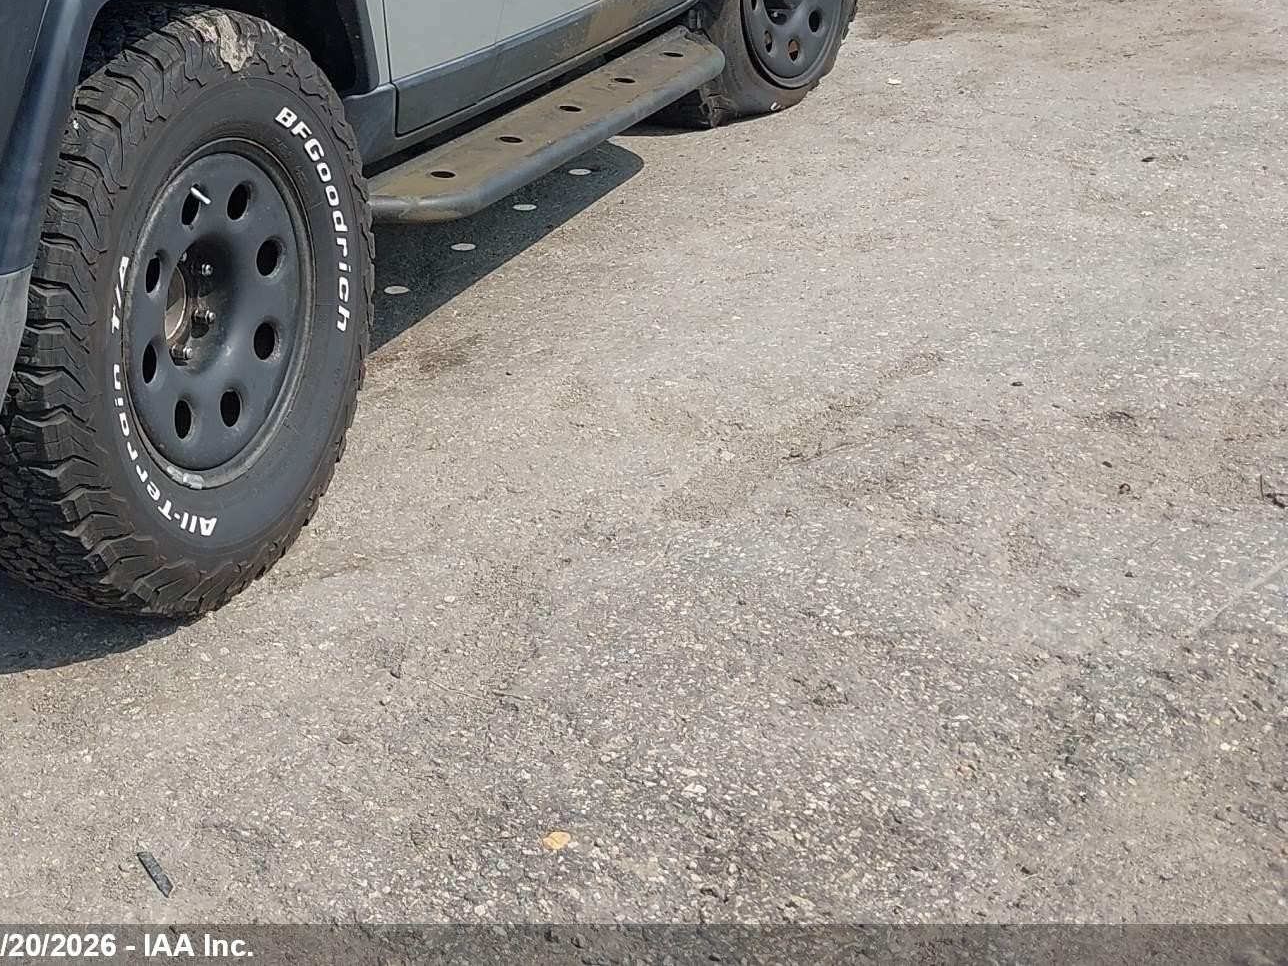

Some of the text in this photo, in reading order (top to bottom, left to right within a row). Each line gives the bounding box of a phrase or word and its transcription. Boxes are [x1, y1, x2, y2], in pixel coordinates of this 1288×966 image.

[274, 106, 352, 332] BFGoodrich
[111, 256, 218, 537] All-Terrain T/A
